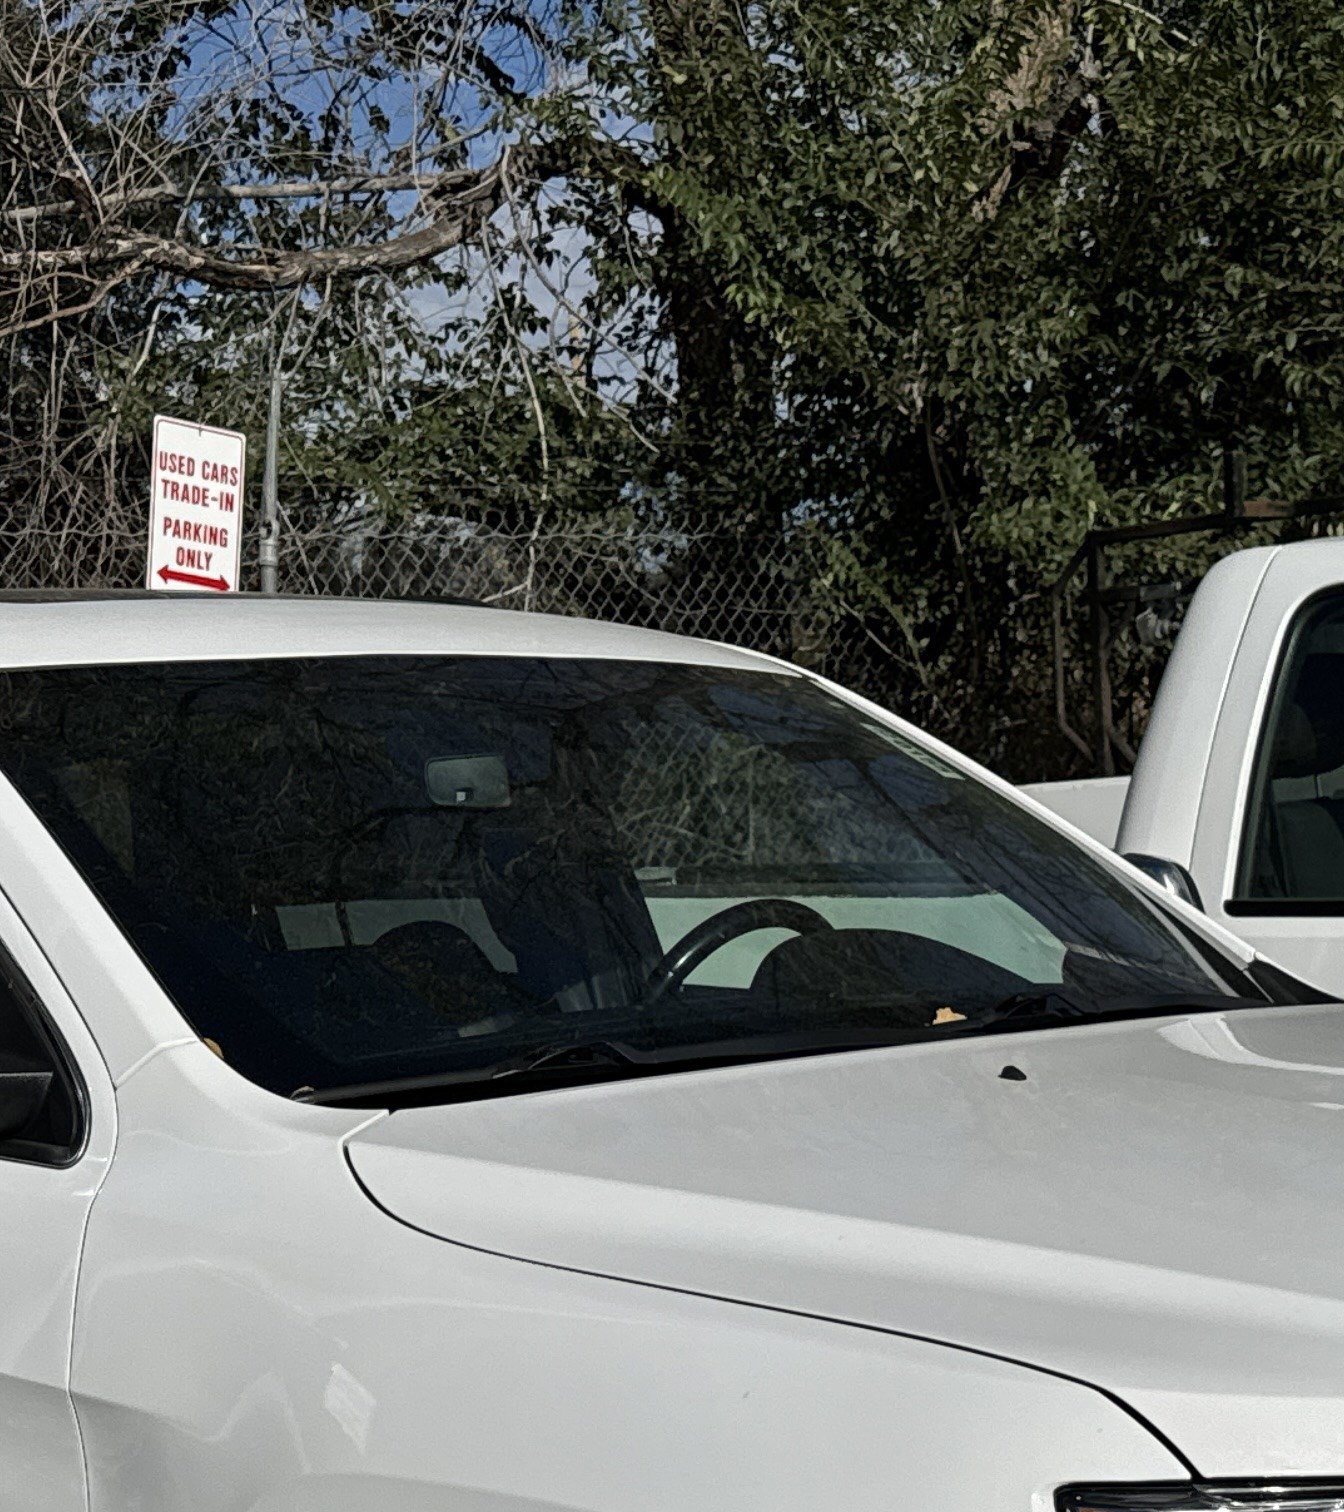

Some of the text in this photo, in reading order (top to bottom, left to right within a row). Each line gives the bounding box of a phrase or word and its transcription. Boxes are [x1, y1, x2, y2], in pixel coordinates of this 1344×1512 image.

[159, 450, 239, 487] USED CARS
[160, 478, 235, 512] TRADE-IN
[162, 516, 229, 548] PARKING
[175, 546, 213, 572] ONLY
